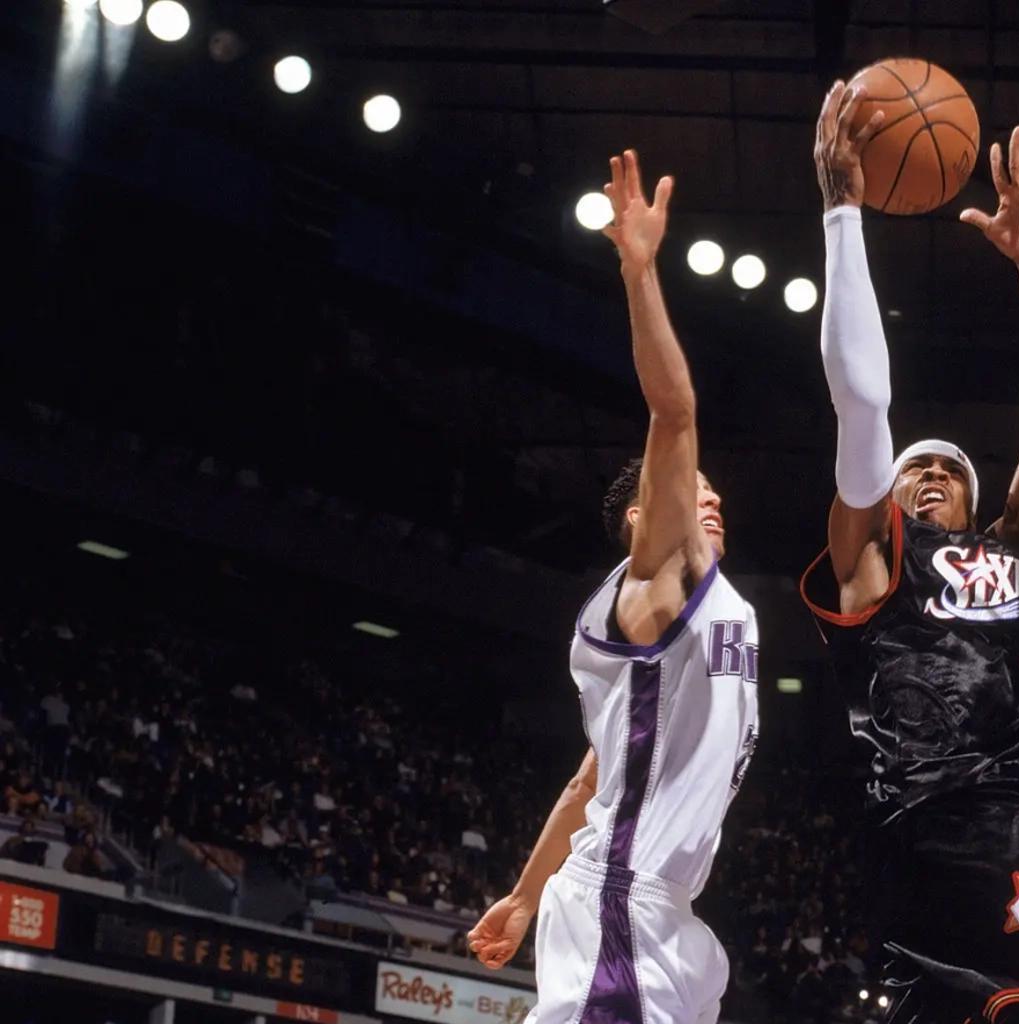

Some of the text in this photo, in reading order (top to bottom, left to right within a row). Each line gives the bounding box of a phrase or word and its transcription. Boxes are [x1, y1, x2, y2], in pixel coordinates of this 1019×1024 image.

[10, 906, 43, 929] 550
[145, 929, 305, 985] DEFENSE
[381, 971, 454, 1015] Raley's
